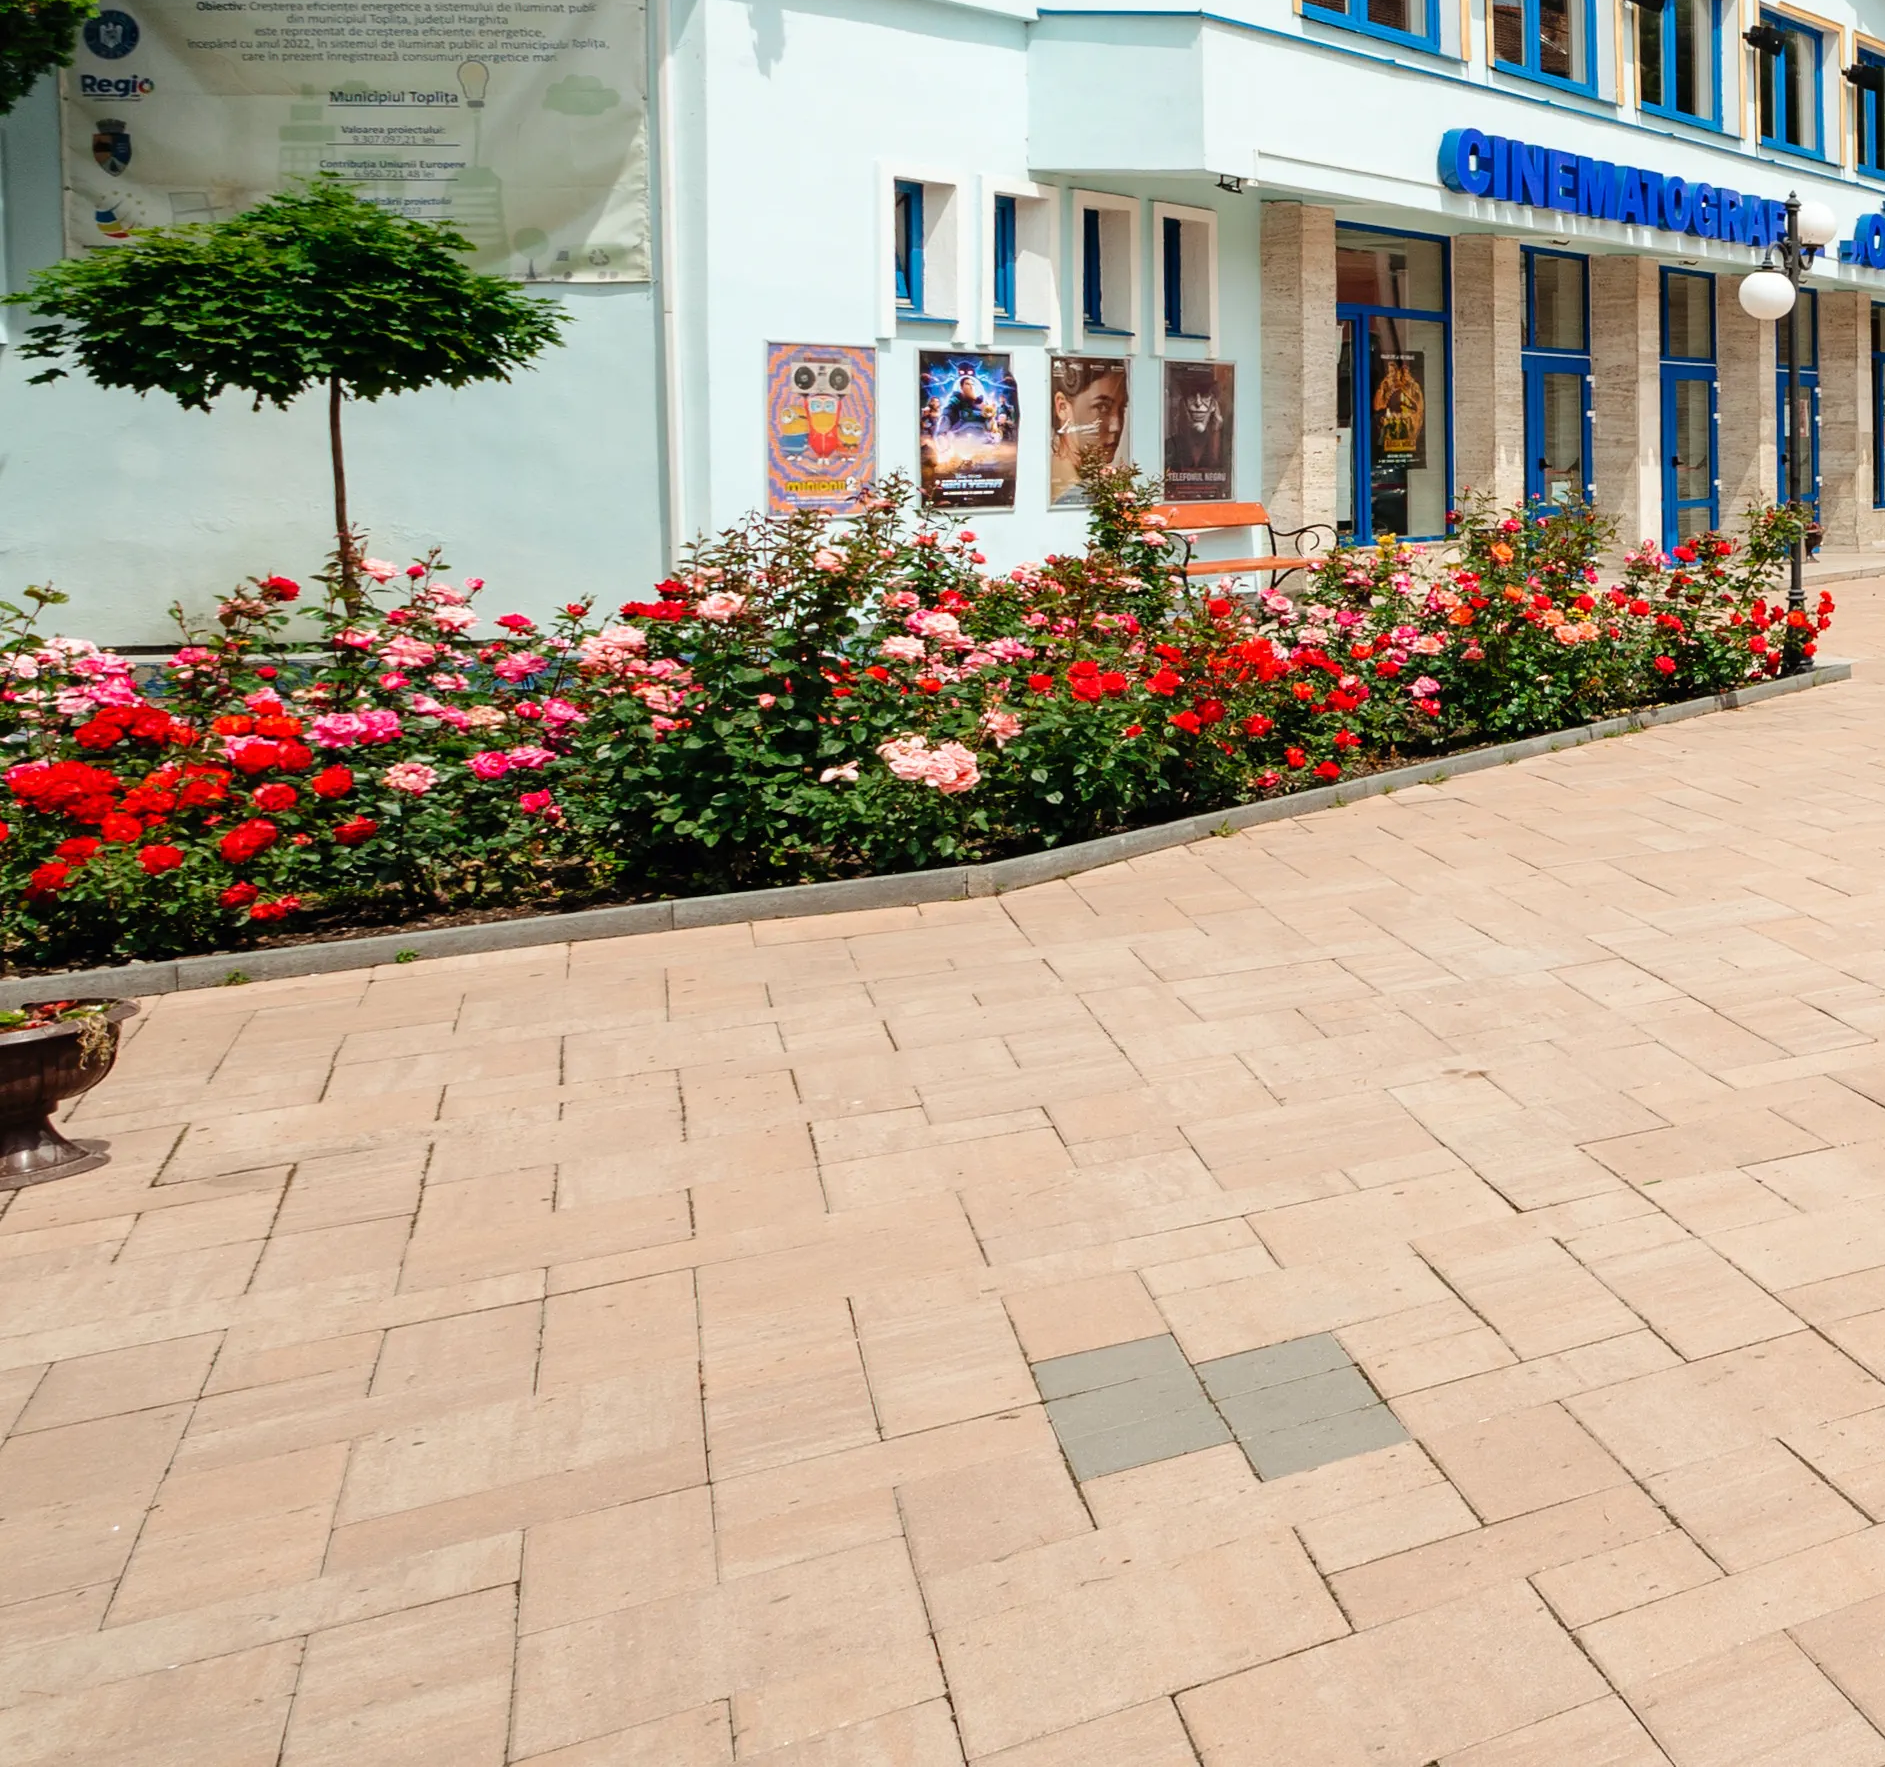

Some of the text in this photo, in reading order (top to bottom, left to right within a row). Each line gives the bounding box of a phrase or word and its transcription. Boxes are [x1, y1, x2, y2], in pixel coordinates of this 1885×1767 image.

[196, 1, 247, 11] Obiectiv:
[361, 3, 422, 14] energetice
[434, 3, 494, 13] sistemului
[497, 3, 512, 12] de
[515, 3, 564, 13] iluminat
[287, 14, 304, 24] din
[308, 14, 367, 26] municipiul
[458, 14, 508, 26] Harghita
[254, 28, 276, 36] este
[280, 27, 345, 38] reprezentat
[348, 27, 363, 36] de
[240, 40, 253, 48] cu
[255, 38, 280, 48] anul
[330, 38, 378, 48] sistemul
[381, 39, 396, 48] de
[398, 39, 445, 49] iluminat
[449, 39, 484, 51] public
[486, 39, 498, 49] al
[242, 53, 264, 62] care
[282, 53, 325, 64] prezent
[466, 53, 529, 64] energetice
[80, 74, 155, 97] Regio
[329, 90, 405, 105] Municipiul
[1439, 127, 1825, 257] CINEMATOGRAF
